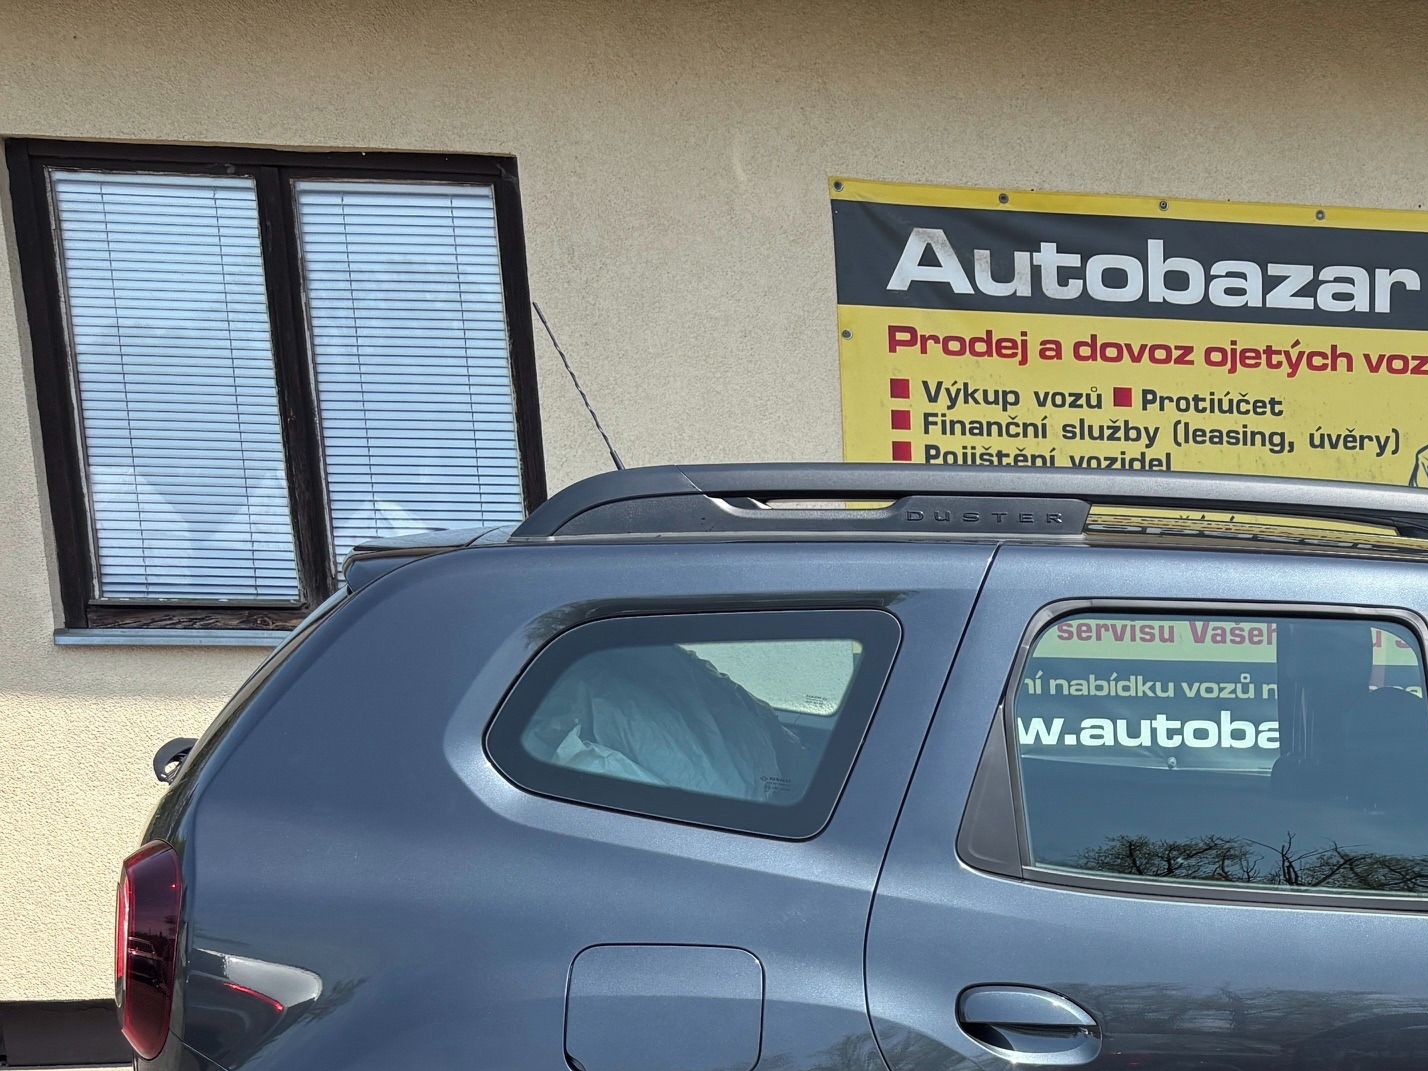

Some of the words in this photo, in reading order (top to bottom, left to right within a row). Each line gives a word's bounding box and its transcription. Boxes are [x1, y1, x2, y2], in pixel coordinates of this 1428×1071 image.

[886, 227, 1421, 313] Autobazar
[887, 325, 1028, 366] Prodej
[1038, 341, 1063, 361] a
[1072, 333, 1195, 366] dovoz
[1203, 338, 1354, 378] ojetých
[922, 379, 1020, 410] Výkup
[1033, 386, 1102, 410] vozů
[1141, 388, 1284, 417] Protiúčet
[923, 414, 1047, 440] Finanční
[1061, 417, 1160, 448] služby
[1172, 419, 1296, 454] (leasing,
[1309, 426, 1400, 458] úvěry)
[905, 510, 1063, 525] DUSTER
[1056, 619, 1176, 643] servisu
[1049, 672, 1175, 698] nabídku
[1180, 673, 1255, 699] vozů
